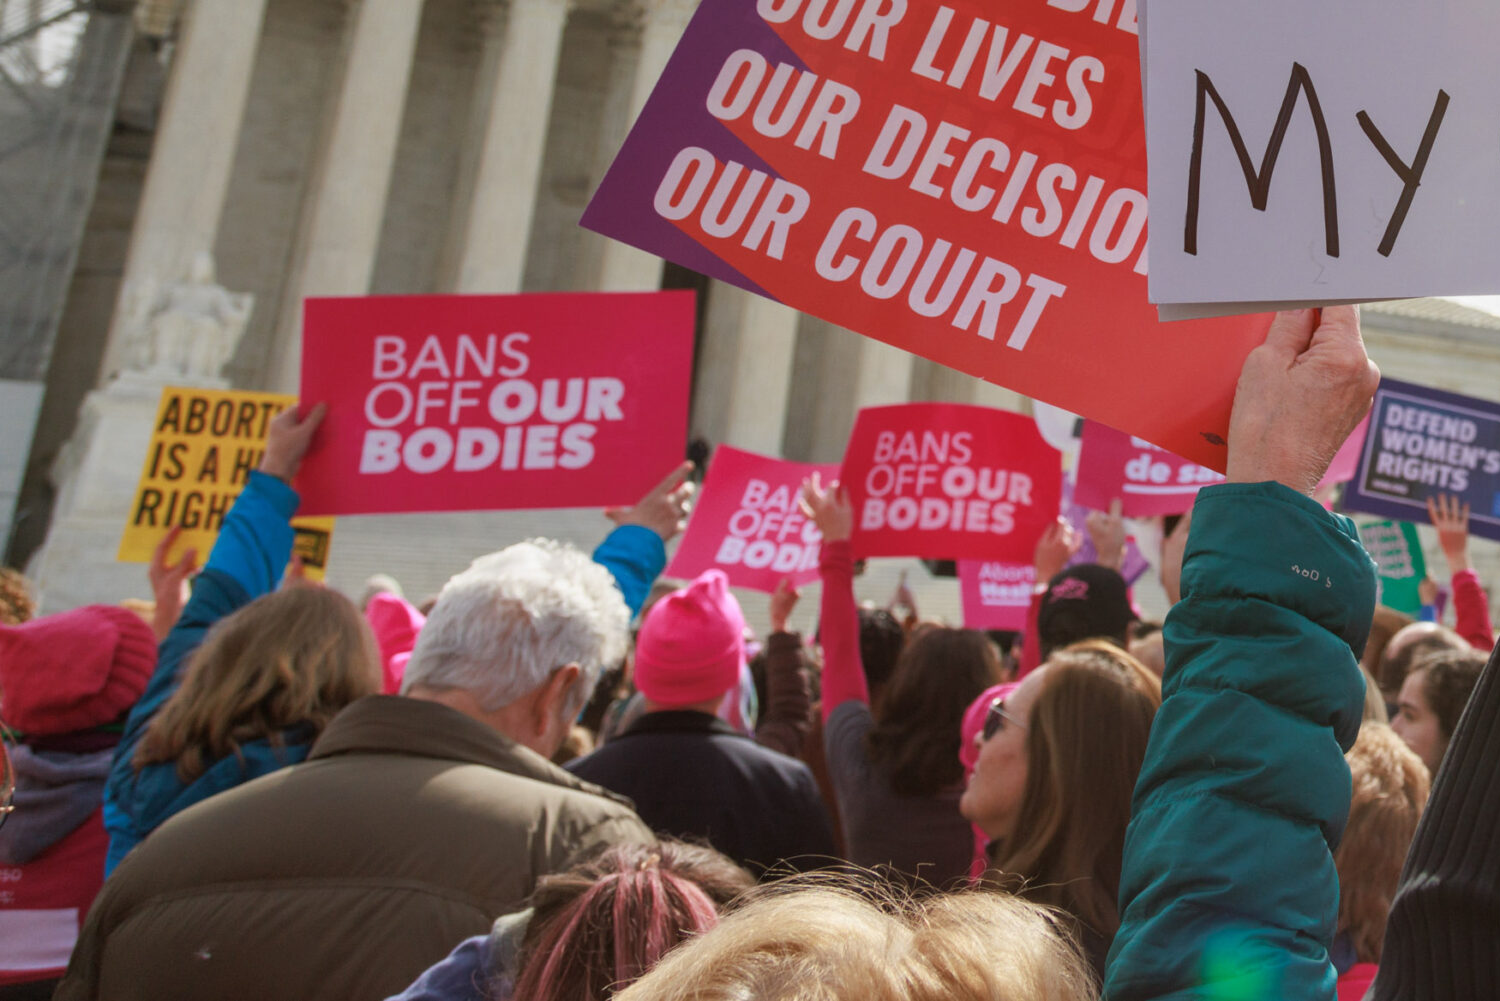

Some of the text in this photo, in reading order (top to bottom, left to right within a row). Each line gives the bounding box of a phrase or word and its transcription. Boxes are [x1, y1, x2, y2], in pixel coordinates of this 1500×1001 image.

[911, 5, 1105, 130] LIVES
[706, 48, 1148, 276] OUR DECISIO
[653, 146, 1067, 351] OUR COURT
[372, 332, 531, 380] BANS
[157, 395, 283, 439] ABORT
[364, 377, 625, 427] OFF OUR
[1385, 403, 1478, 443] DEFEND
[149, 441, 189, 481] IS
[198, 445, 219, 483] A
[359, 422, 598, 474] BODIES
[873, 431, 973, 465] BANS
[1125, 453, 1171, 483] de
[865, 464, 1033, 506] OFF OUR
[1376, 452, 1469, 492] RIGHTS
[134, 488, 240, 531] RIGH
[728, 508, 804, 543] OFF
[860, 497, 1016, 535] BODIES
